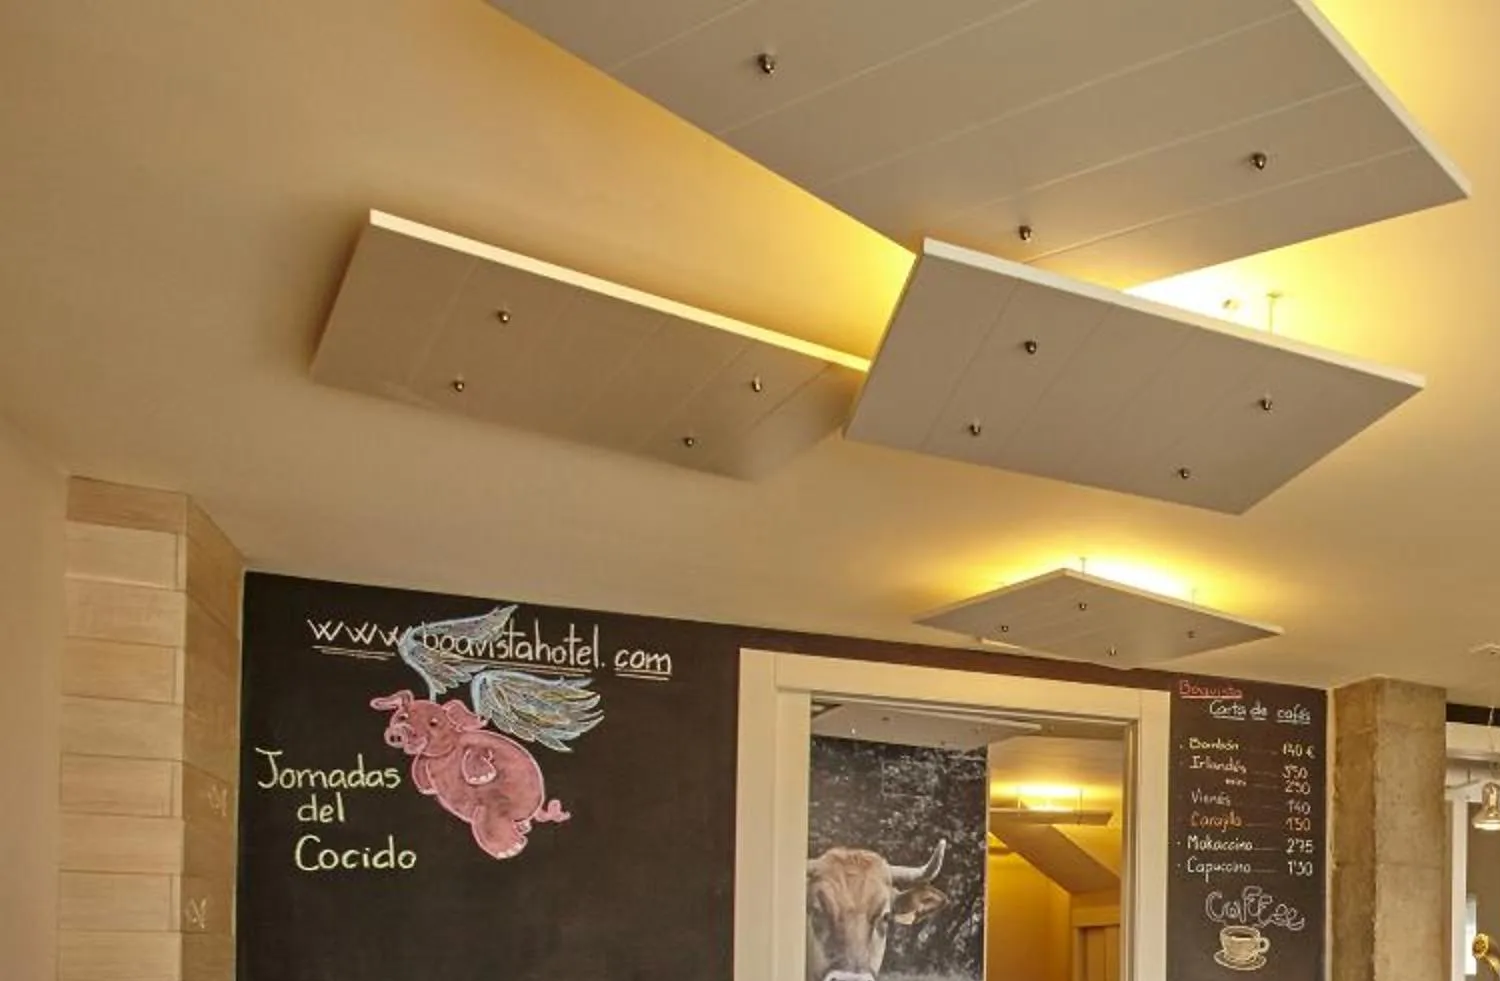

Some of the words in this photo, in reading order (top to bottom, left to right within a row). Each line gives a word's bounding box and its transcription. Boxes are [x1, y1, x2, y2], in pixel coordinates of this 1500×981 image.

[1209, 699, 1247, 719] Carta
[1249, 701, 1268, 719] de
[255, 747, 401, 790] Jornadas
[297, 791, 346, 823] del
[295, 833, 418, 872] Cocido
